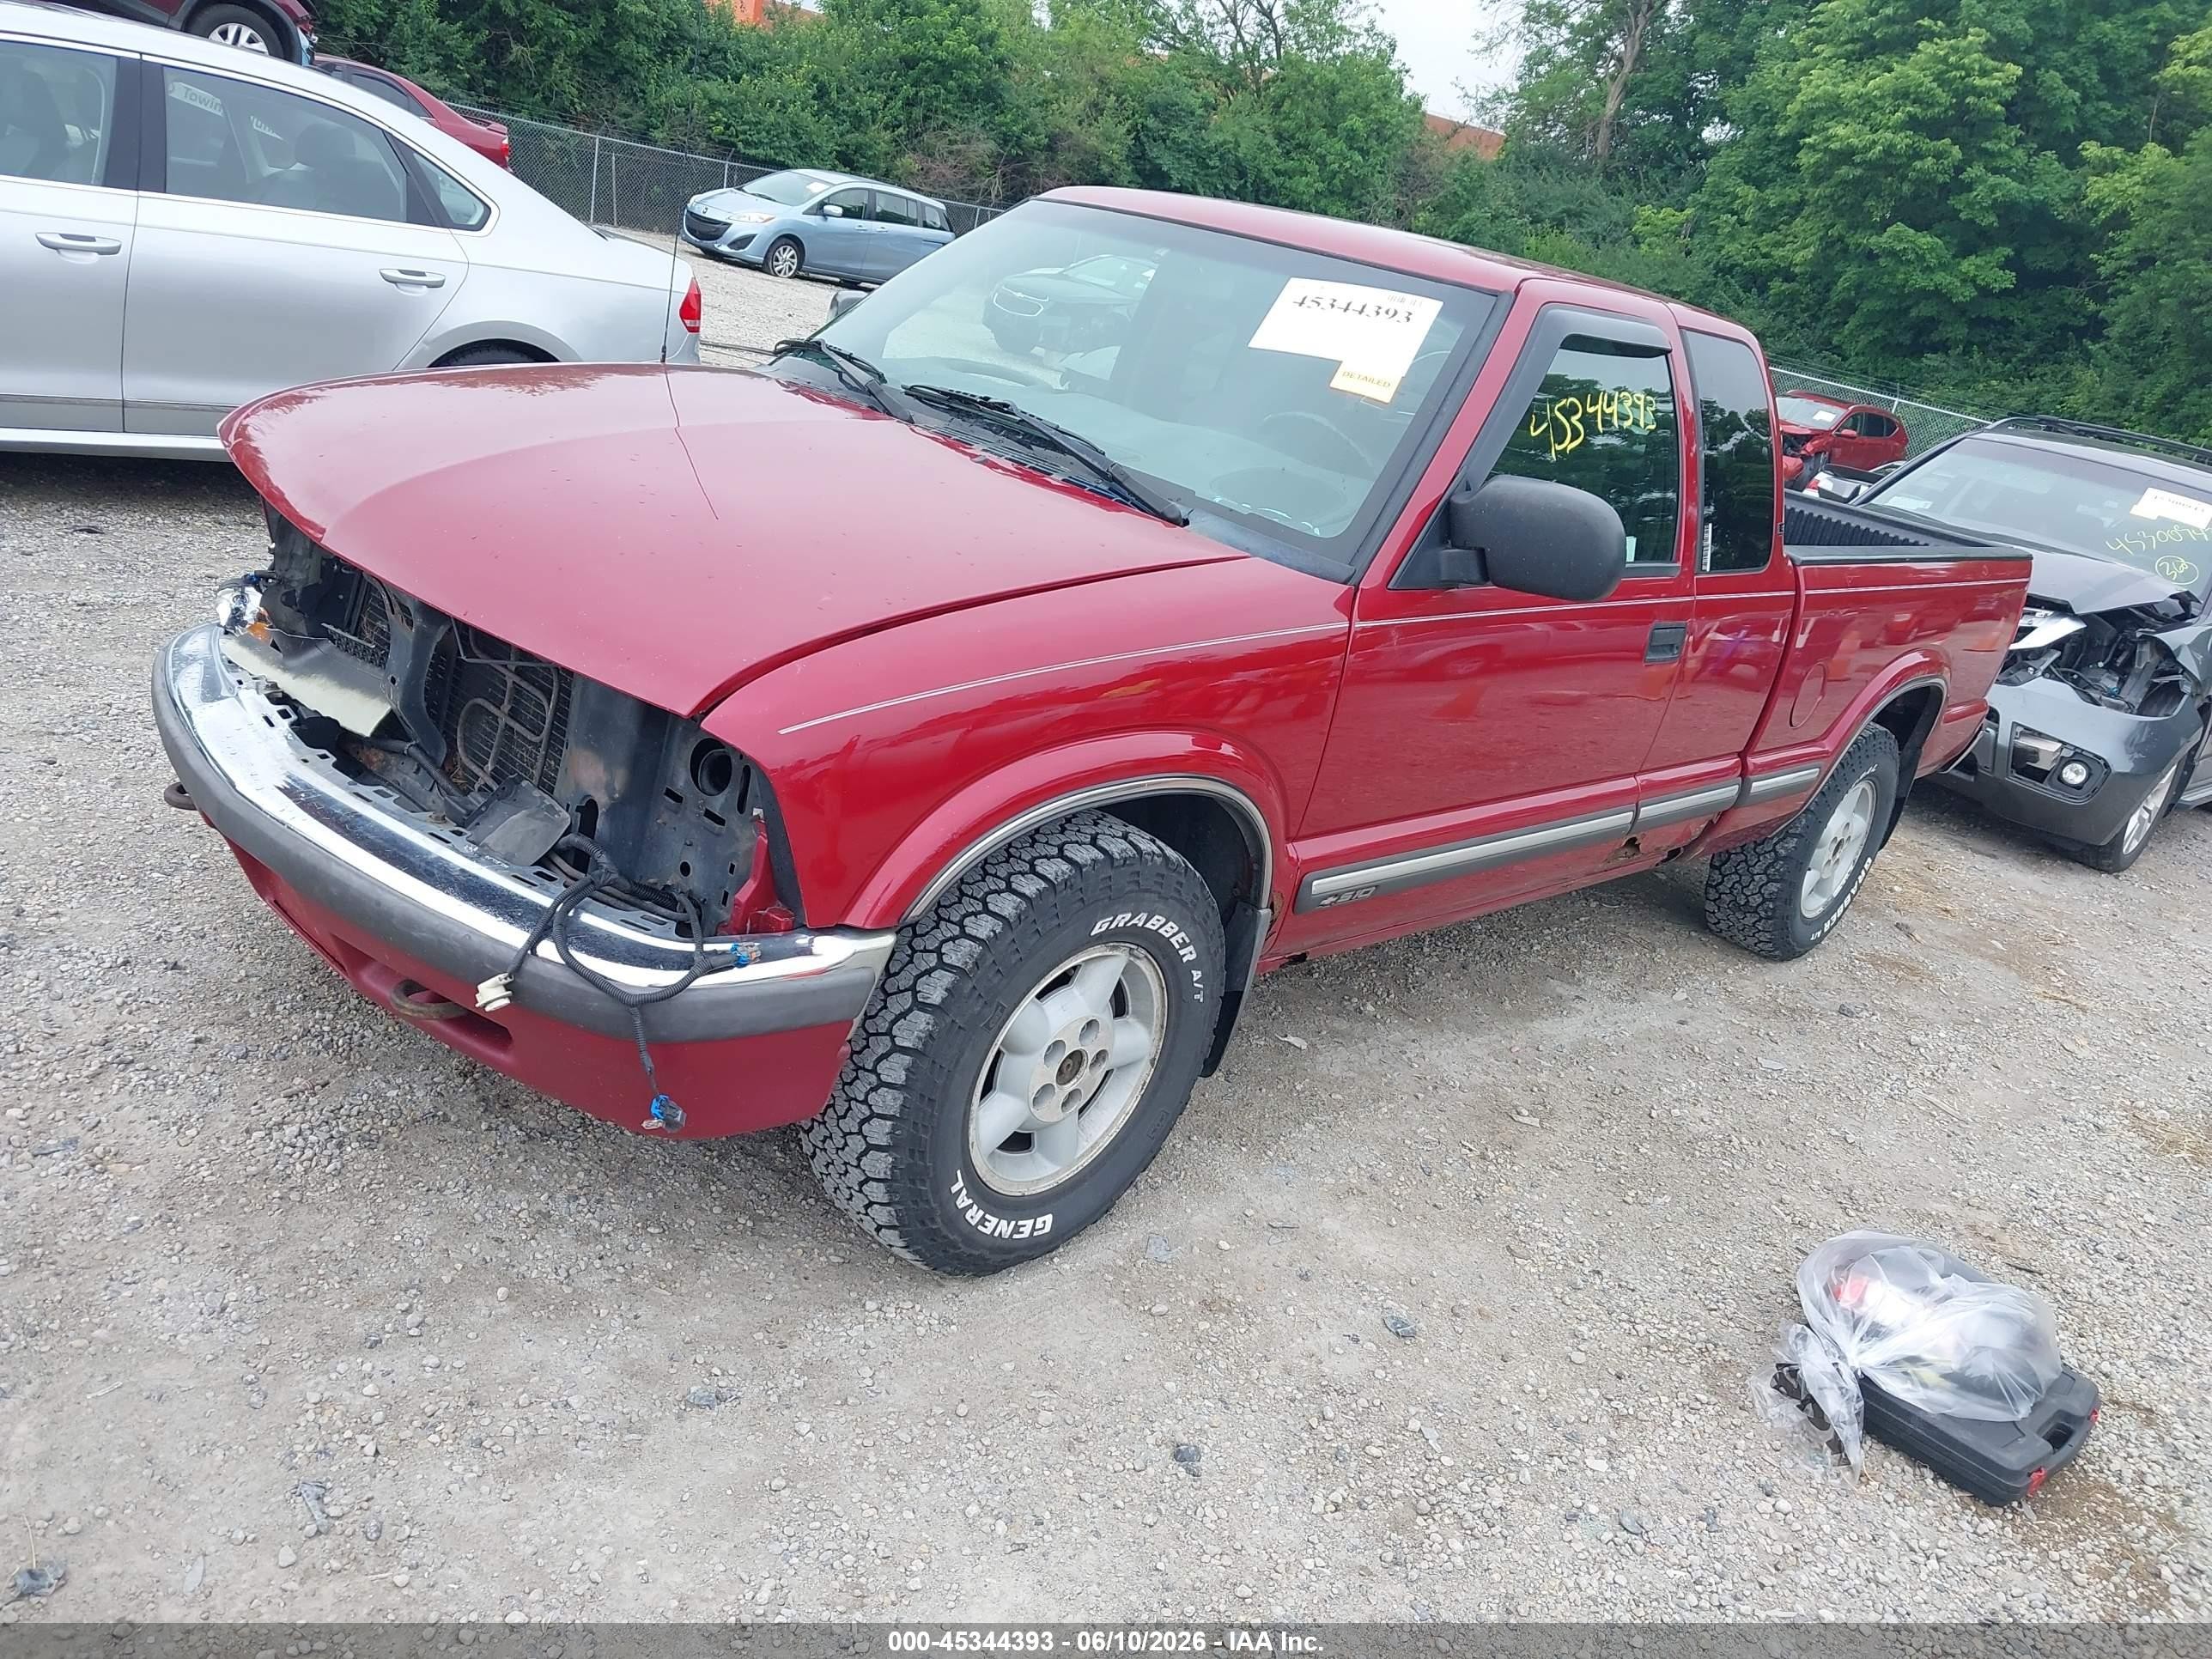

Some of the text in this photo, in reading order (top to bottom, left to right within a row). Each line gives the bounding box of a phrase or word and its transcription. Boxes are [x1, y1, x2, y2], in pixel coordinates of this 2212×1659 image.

[184, 88, 222, 112] Towin
[1292, 295, 1413, 324] 45344393
[1342, 370, 1391, 388] DETAILED
[1530, 391, 1656, 461] 45344393
[1823, 857, 1872, 933] GRABBER
[1090, 912, 1204, 1002] GRABBER A/T
[951, 1169, 1053, 1238] GENERAL
